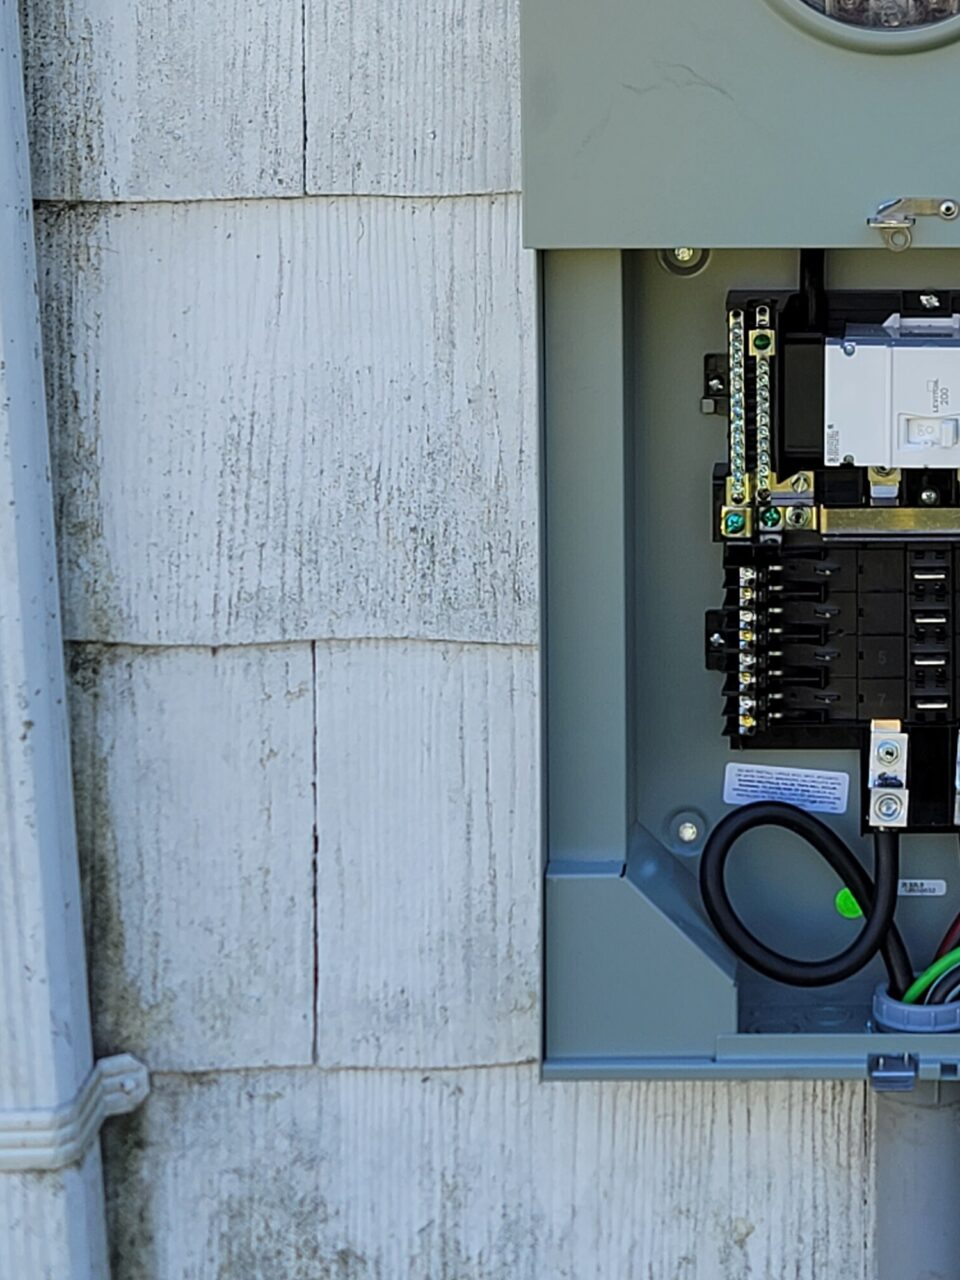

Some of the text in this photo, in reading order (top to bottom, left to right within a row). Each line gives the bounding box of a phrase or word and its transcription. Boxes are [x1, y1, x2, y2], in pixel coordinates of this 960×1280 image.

[940, 387, 949, 406] 200
[878, 650, 887, 665] 5
[878, 693, 887, 707] 7
